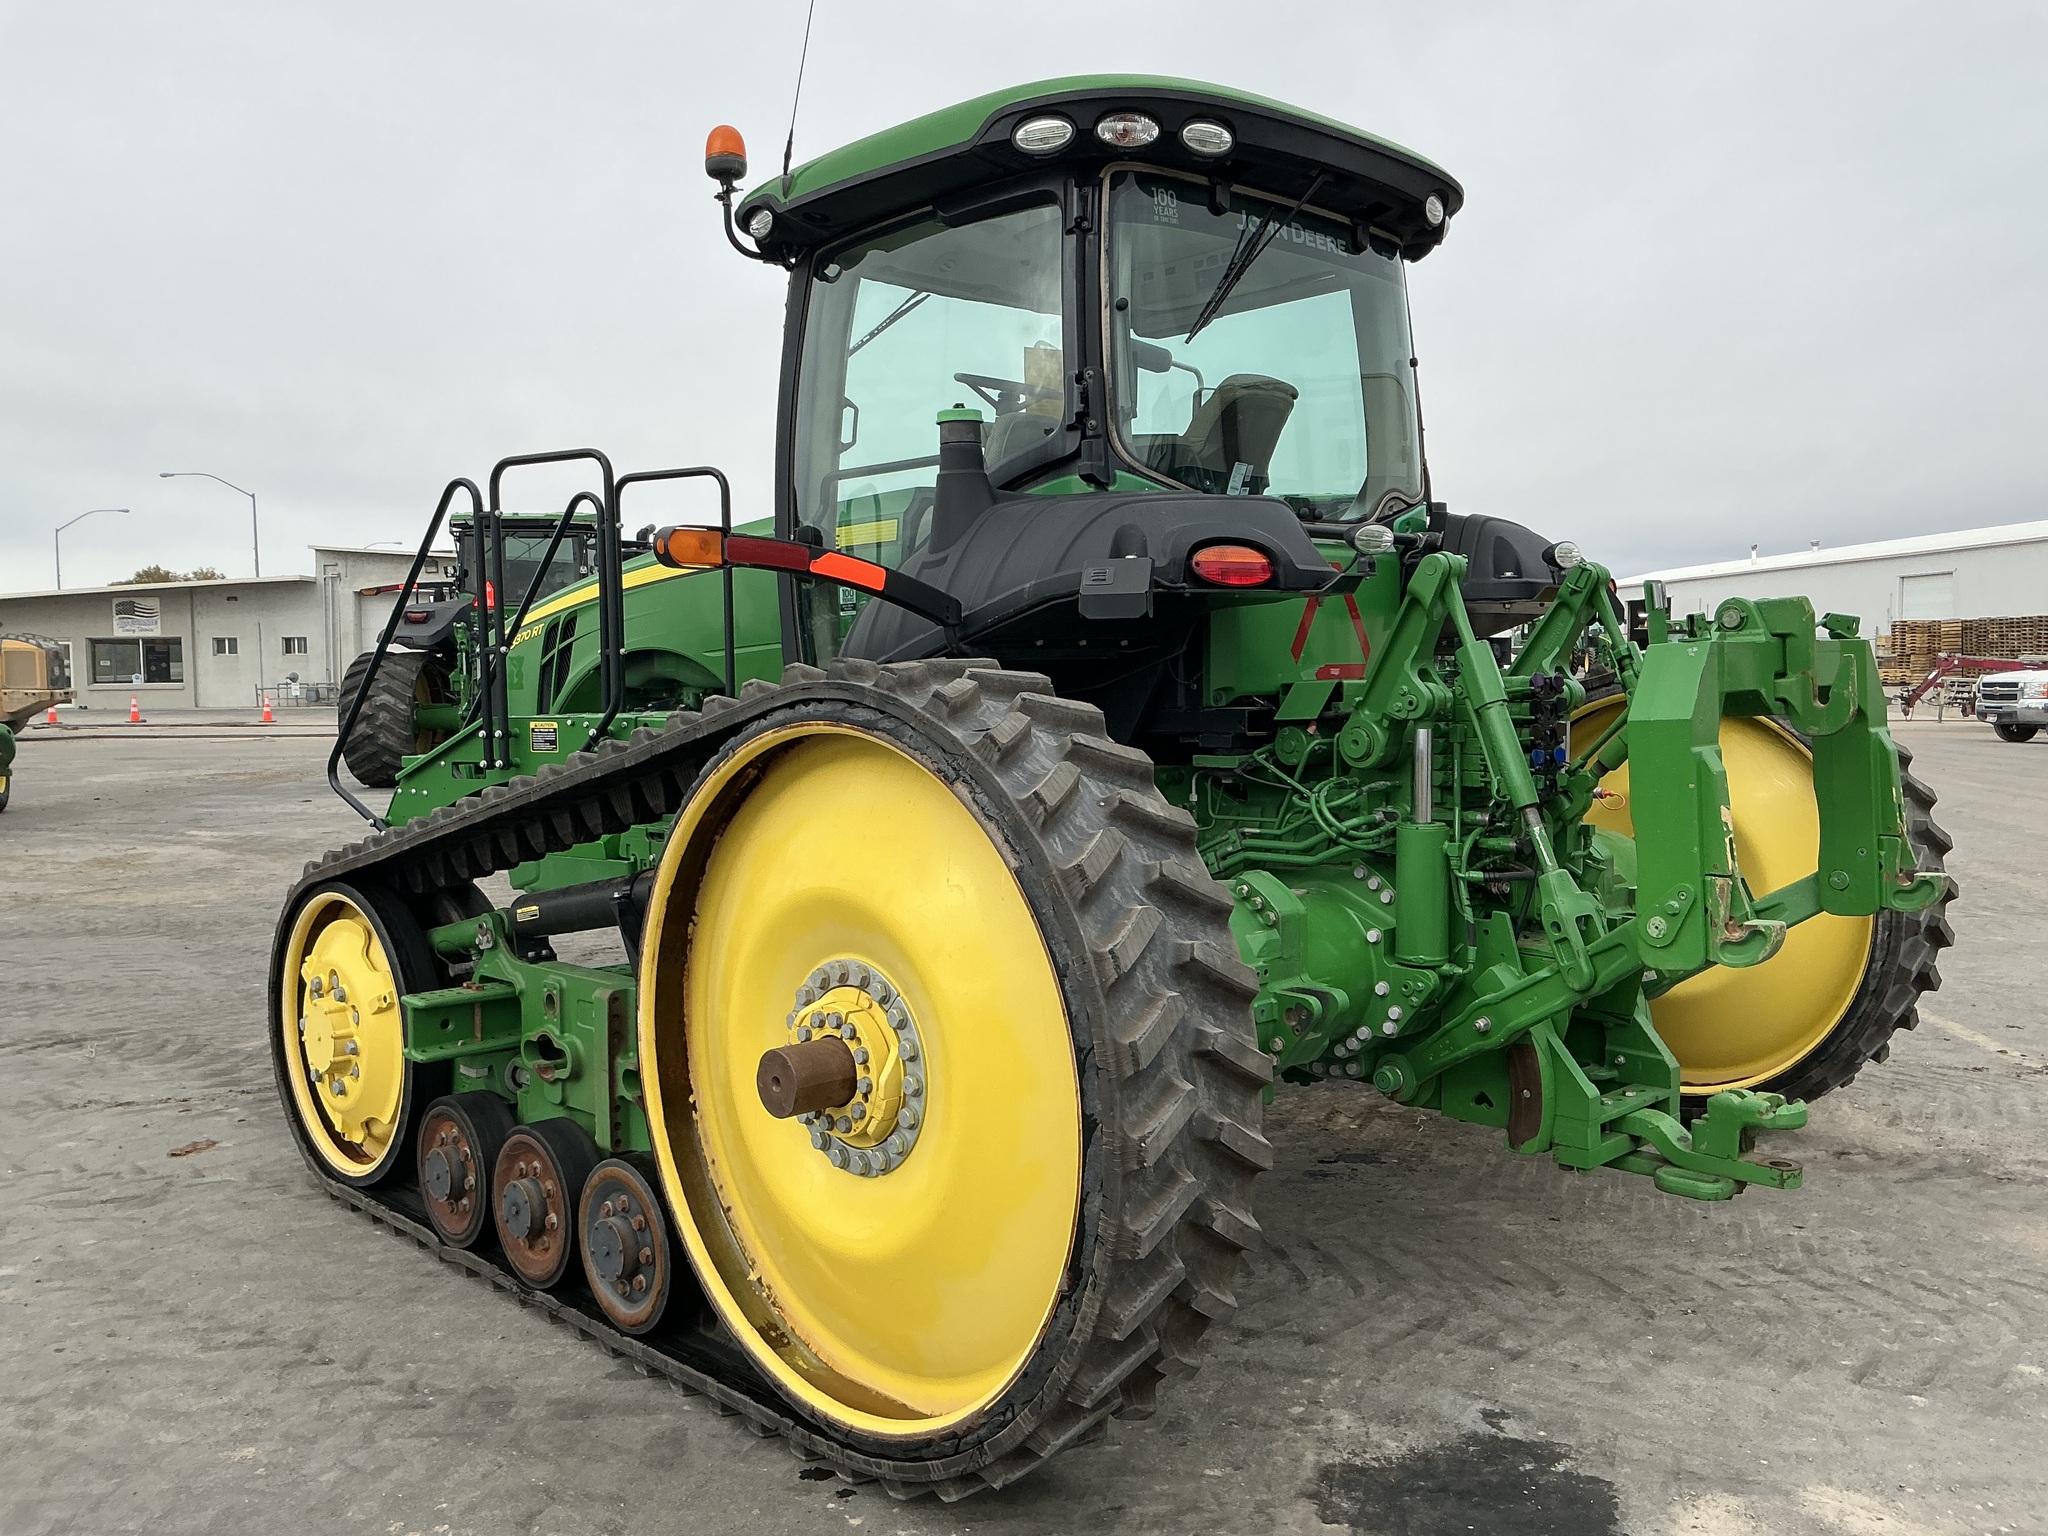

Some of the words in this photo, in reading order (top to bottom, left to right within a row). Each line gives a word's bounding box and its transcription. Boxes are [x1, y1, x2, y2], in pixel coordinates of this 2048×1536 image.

[1151, 187, 1176, 207] 100
[1153, 205, 1179, 218] YEARS
[1291, 222, 1347, 257] DEERE
[531, 623, 545, 638] RT
